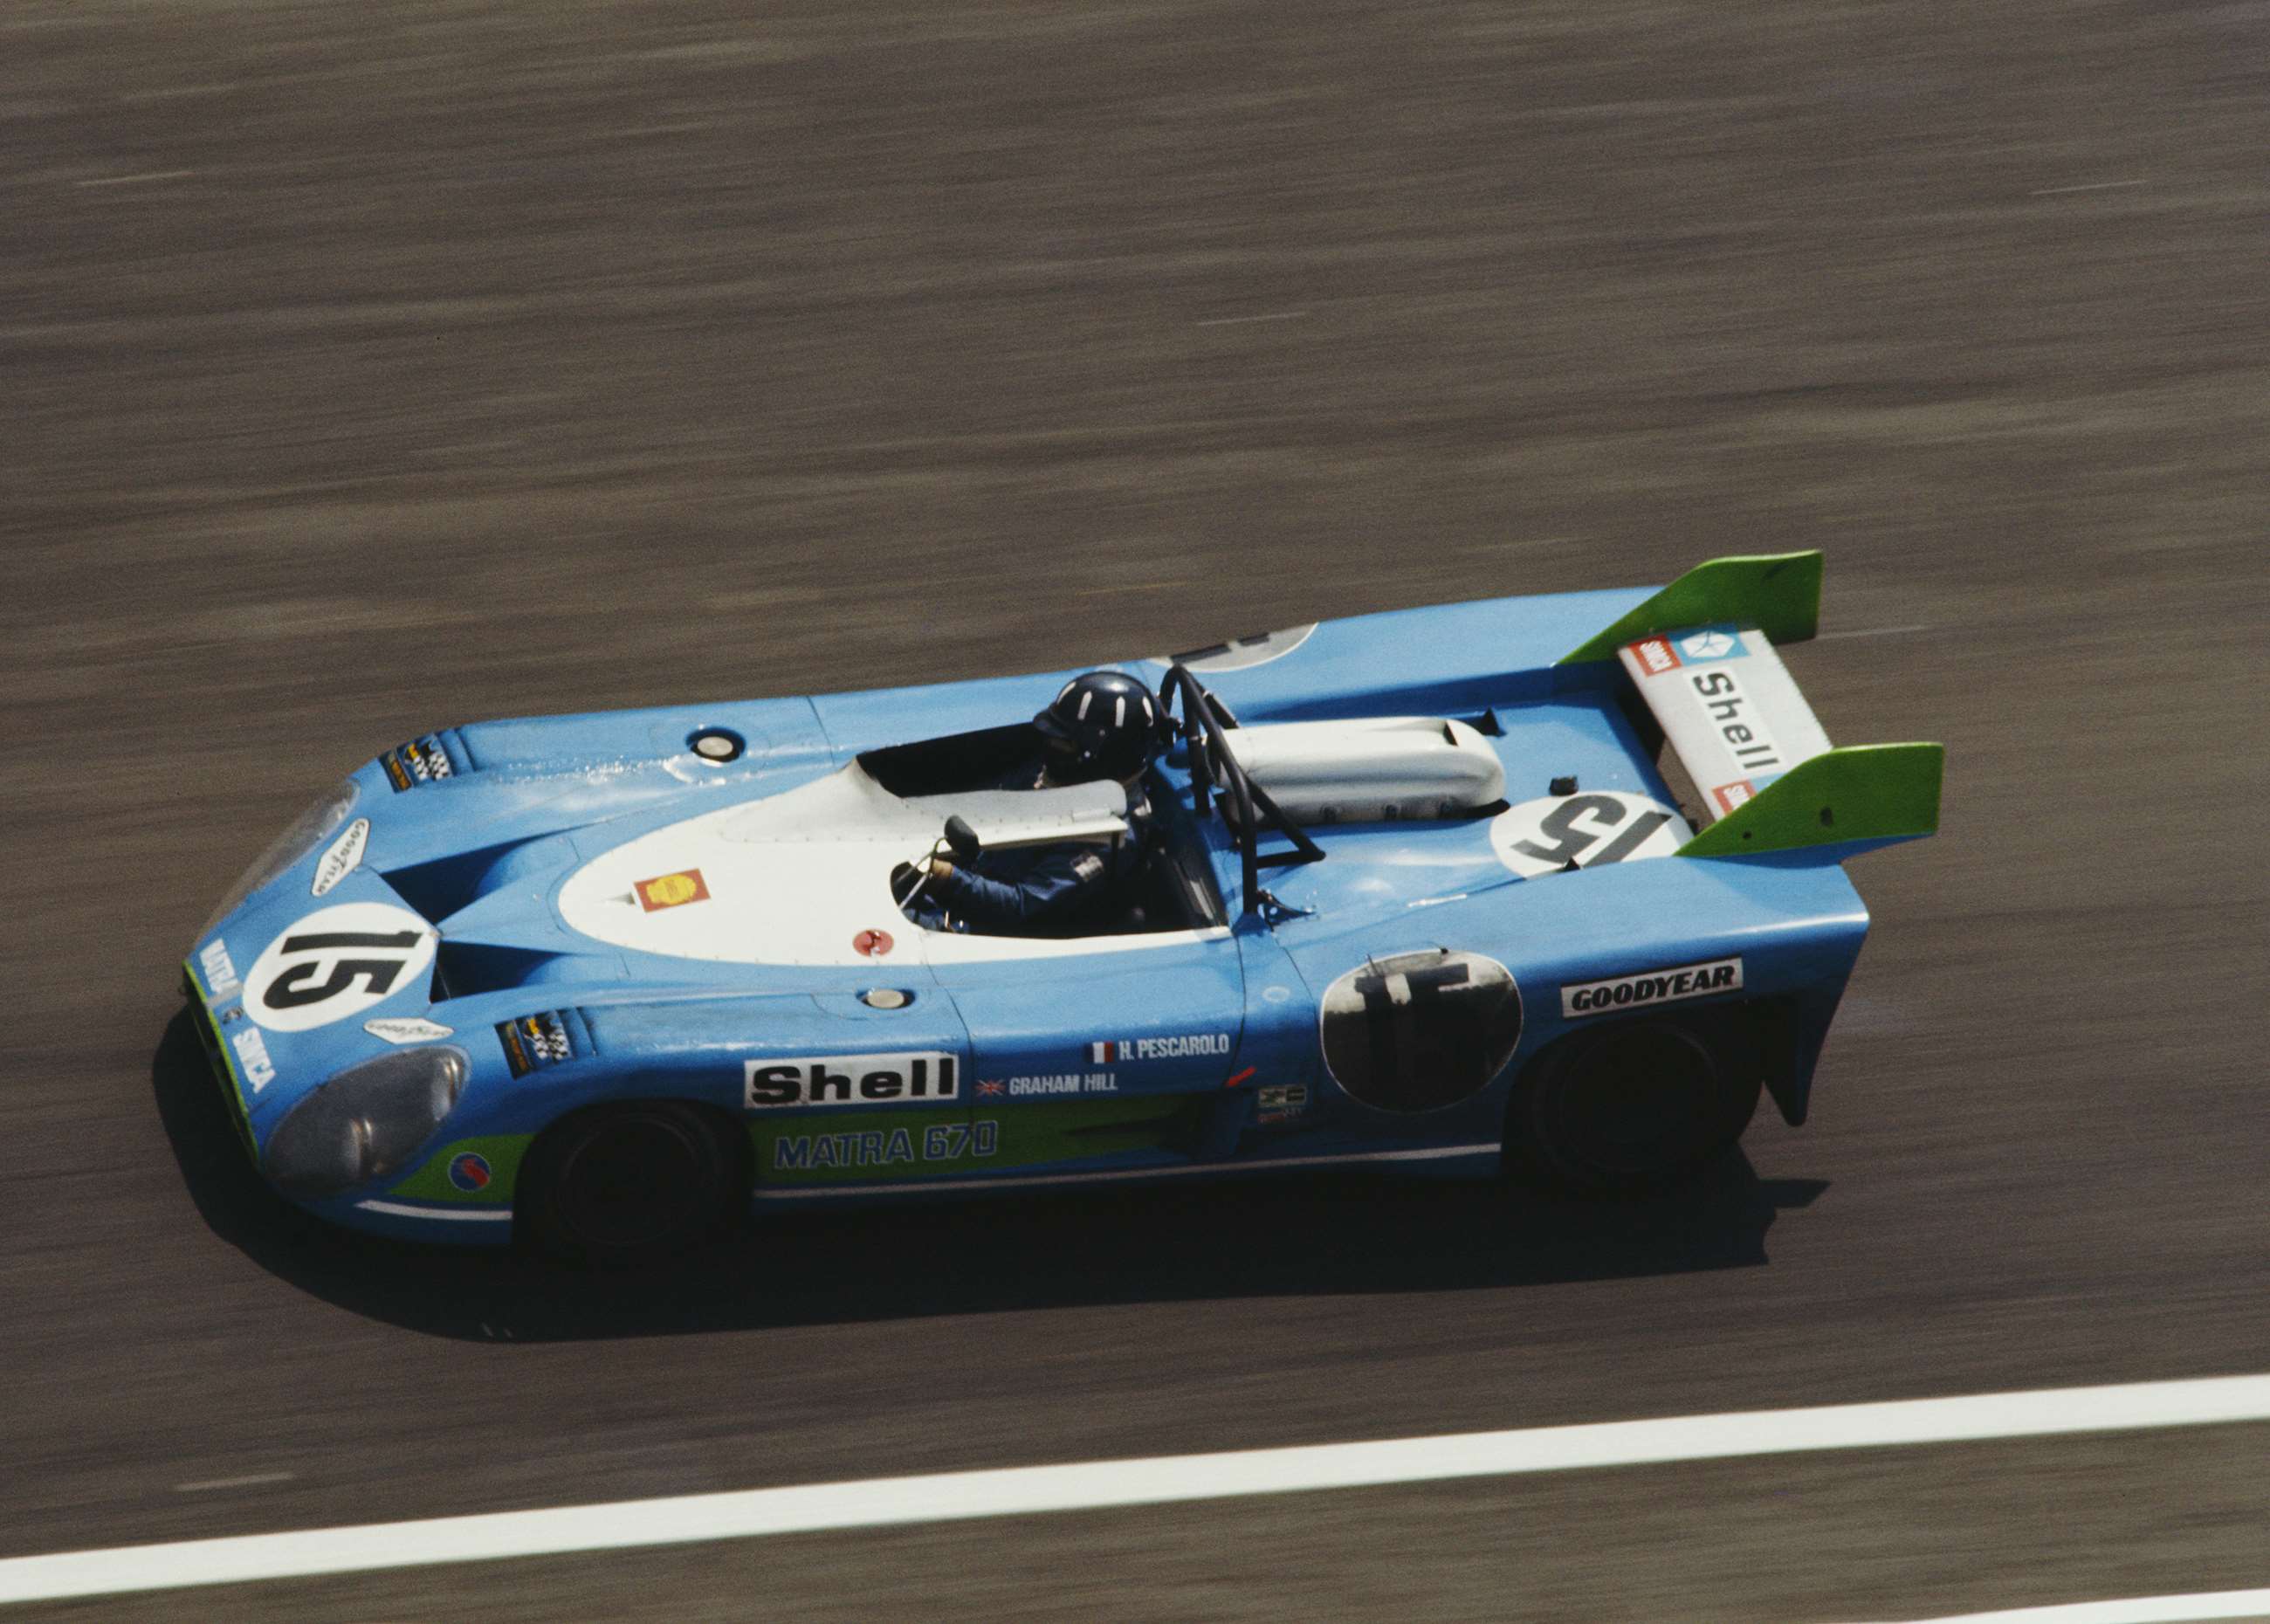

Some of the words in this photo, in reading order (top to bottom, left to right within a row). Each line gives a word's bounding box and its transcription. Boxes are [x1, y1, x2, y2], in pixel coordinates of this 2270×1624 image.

[1692, 672, 1779, 769] Shell
[1510, 795, 1674, 866] 15
[263, 930, 423, 1009] 15
[1571, 965, 1736, 1011] GOODYEAR
[1118, 1040, 1134, 1061] H.
[1137, 1034, 1229, 1059] PESCAROLO
[752, 1053, 954, 1104] Shell
[1009, 1074, 1080, 1096] GRAHAM
[1084, 1072, 1118, 1091] HILL
[774, 1127, 915, 1170] MATRA
[922, 1119, 999, 1161] 670
